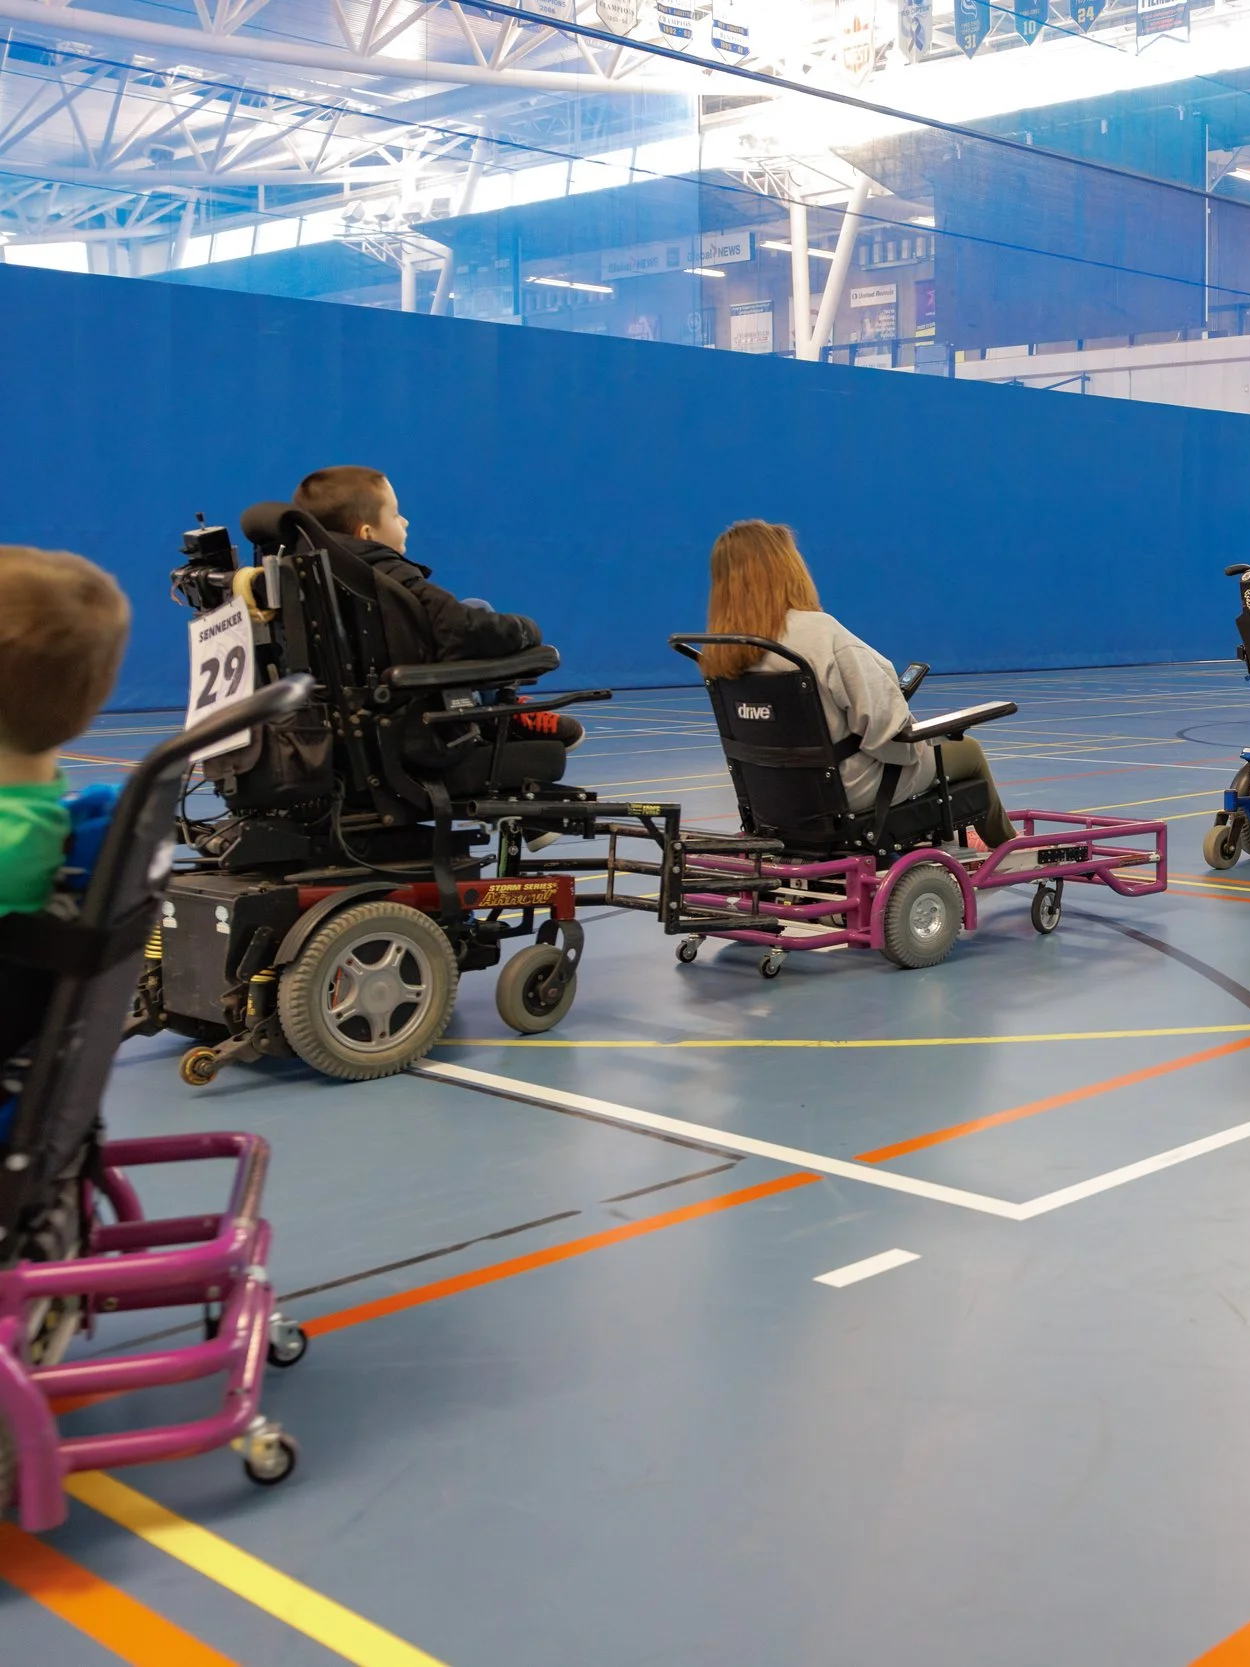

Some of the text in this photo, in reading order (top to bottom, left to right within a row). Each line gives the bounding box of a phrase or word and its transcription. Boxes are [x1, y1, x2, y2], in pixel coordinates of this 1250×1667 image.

[1077, 6, 1095, 23] 24
[1023, 20, 1037, 36] 10
[964, 35, 977, 49] 31
[717, 244, 741, 257] NEWS
[199, 610, 244, 643] SENNEKER
[195, 645, 246, 711] 29
[738, 702, 771, 720] drive
[488, 882, 557, 892] STORM SERIES
